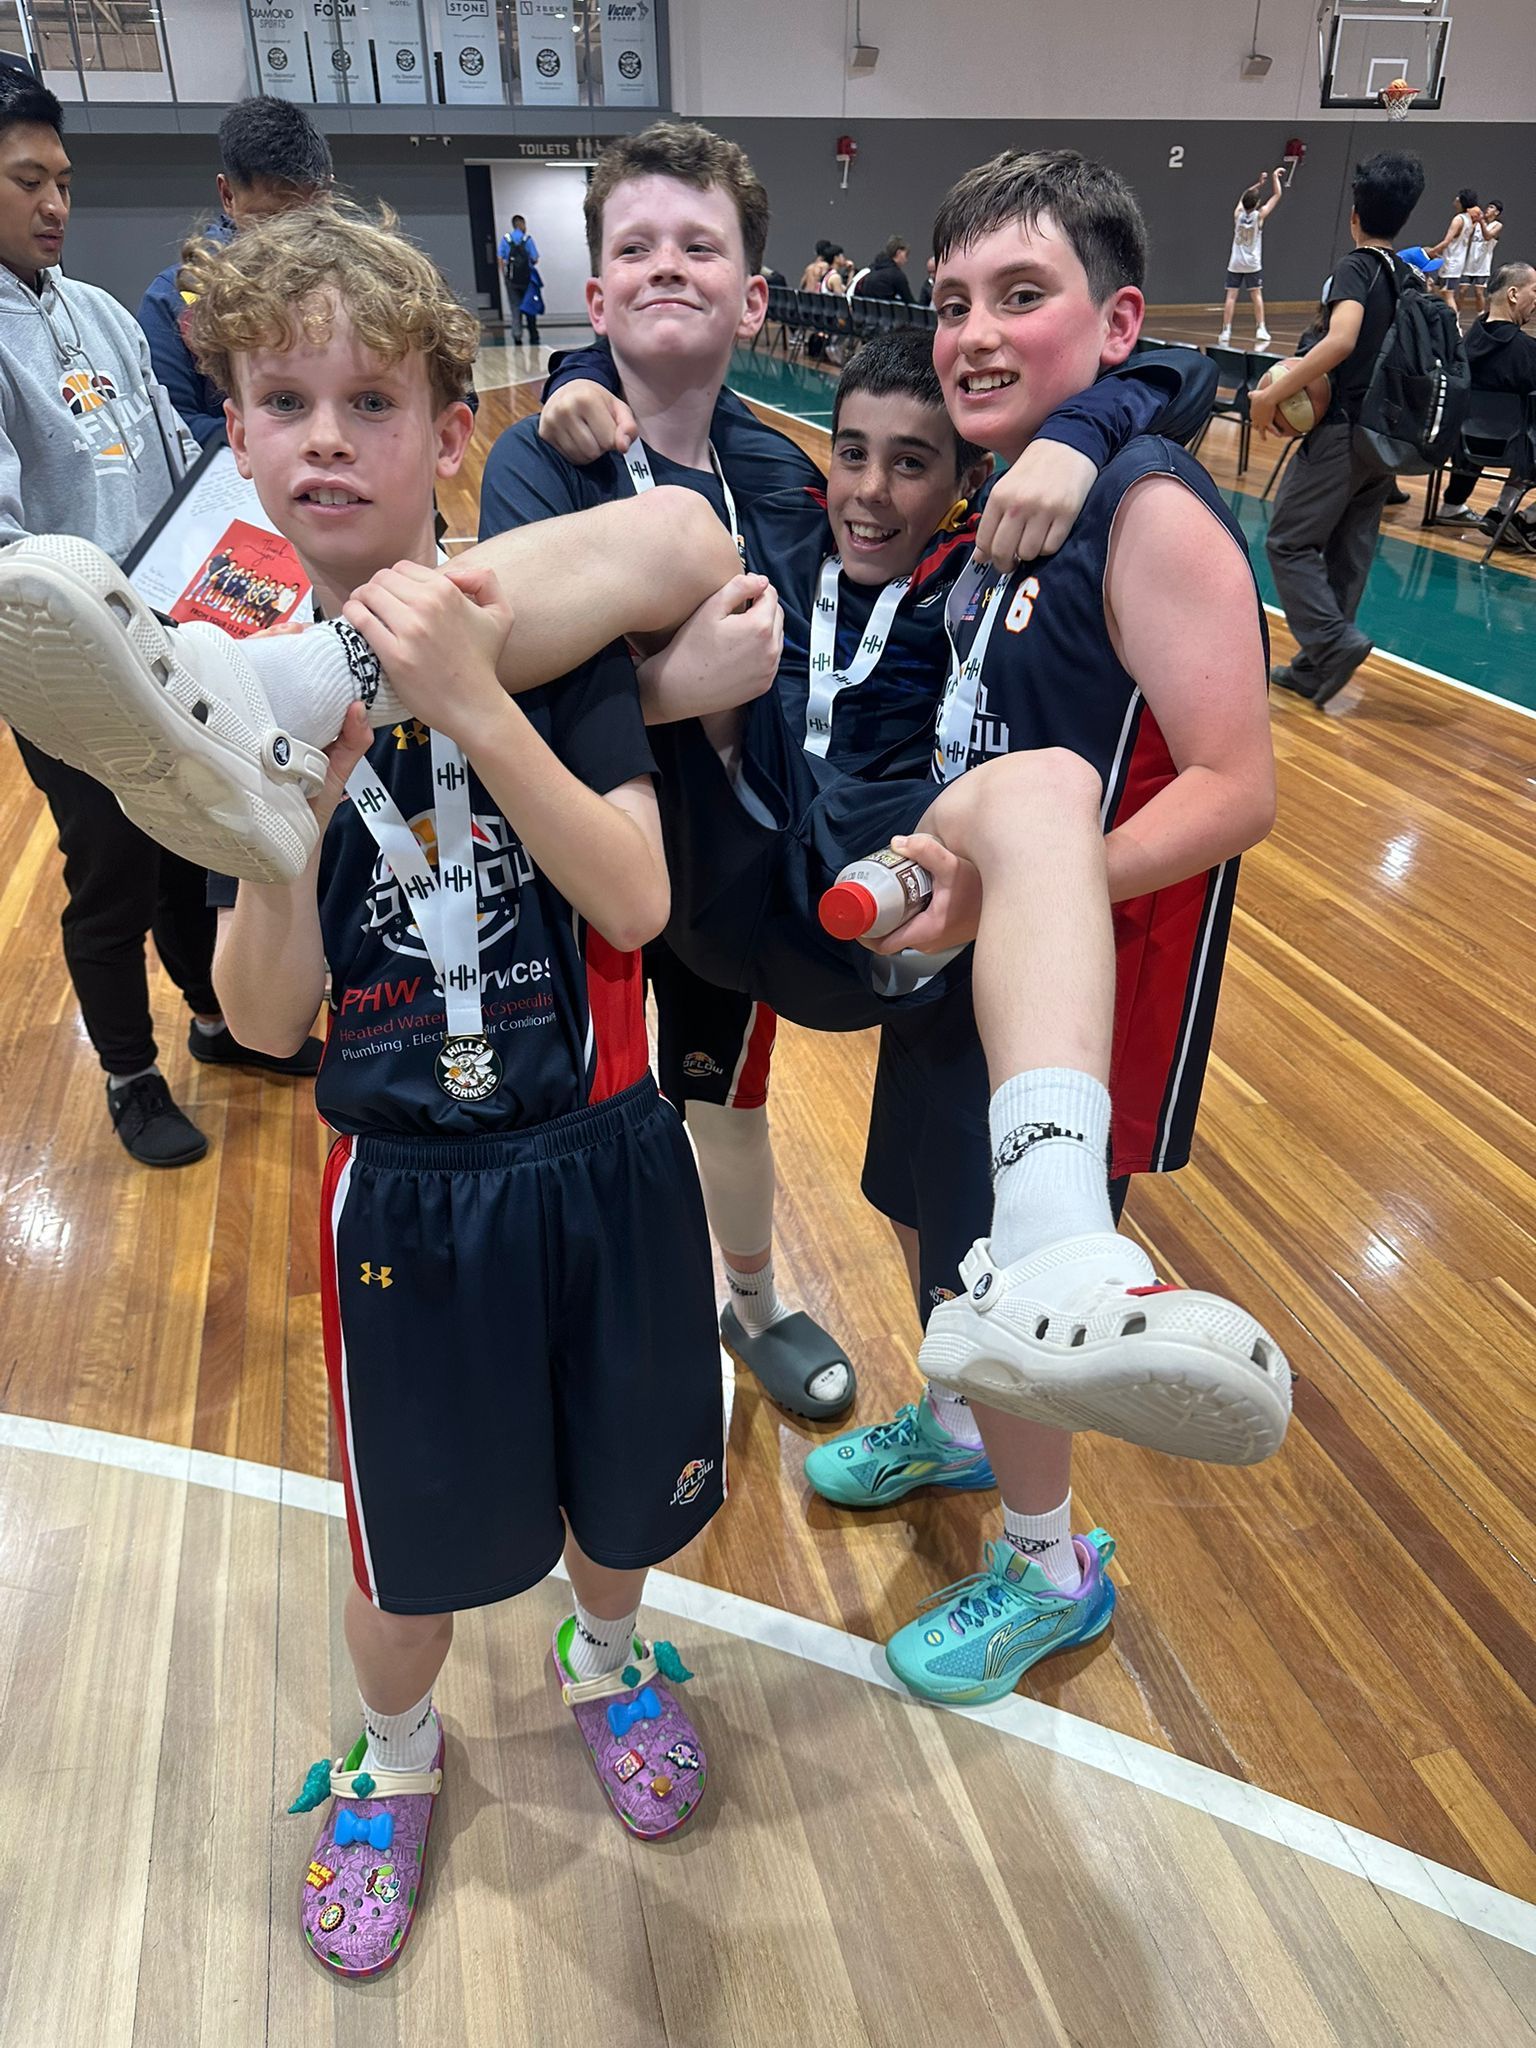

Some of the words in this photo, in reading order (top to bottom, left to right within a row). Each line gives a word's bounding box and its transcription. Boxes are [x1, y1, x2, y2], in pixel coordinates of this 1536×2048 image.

[249, 8, 294, 19] DIAMOND
[314, 4, 356, 16] FORM
[450, 2, 486, 12] STONE
[608, 4, 637, 17] Victor
[519, 143, 570, 155] TOILETS
[1168, 145, 1185, 168] 2
[1004, 575, 1041, 635] 6
[340, 976, 421, 1016] PHW
[432, 957, 551, 998] Srvces
[340, 1019, 394, 1042] Heated
[397, 1011, 446, 1030] Water
[342, 1038, 403, 1061] Plumbing
[445, 1041, 485, 1058] HILLS
[683, 1060, 724, 1074] OFLOW
[443, 1073, 498, 1098] HORNETS
[670, 1459, 714, 1505] JOFLOW
